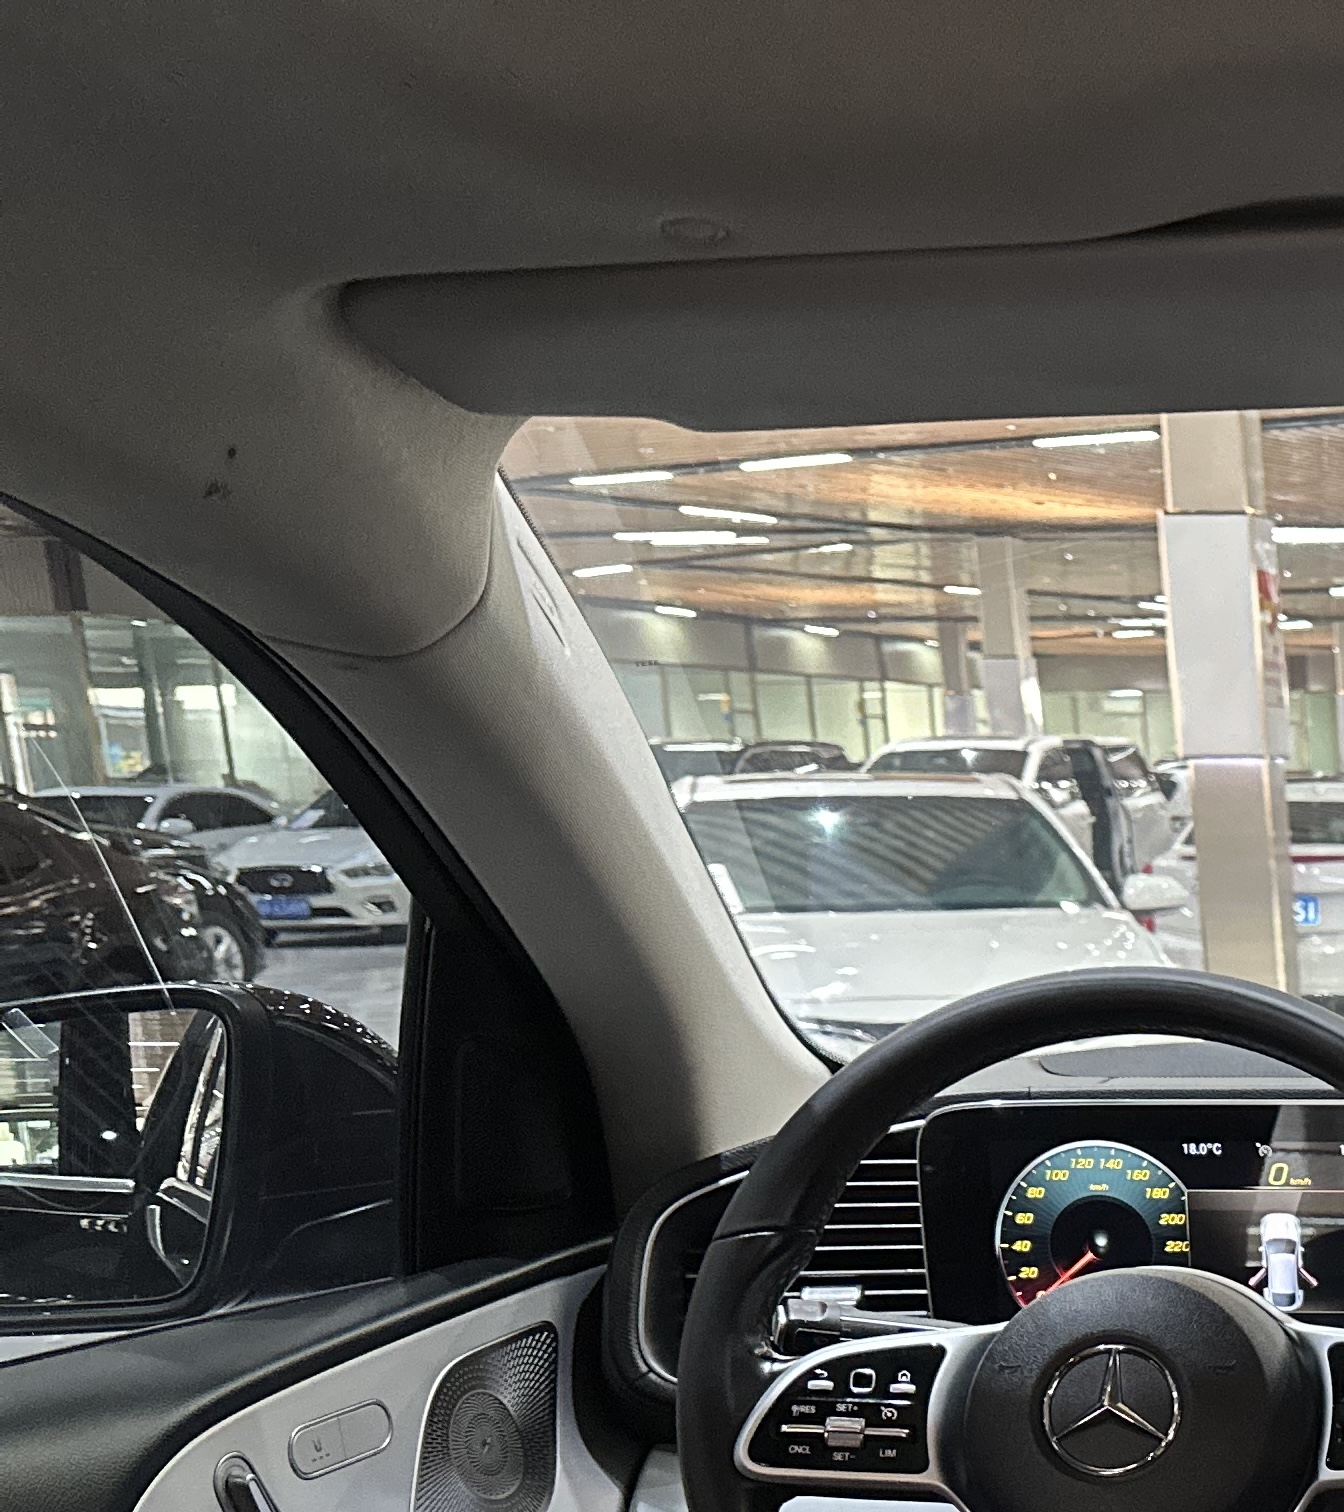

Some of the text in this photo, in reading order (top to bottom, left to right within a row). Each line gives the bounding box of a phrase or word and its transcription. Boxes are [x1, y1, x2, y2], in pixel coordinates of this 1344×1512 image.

[1070, 1158, 1094, 1169] 120
[1100, 1158, 1123, 1169] 140
[1045, 1170, 1069, 1181] 100
[1126, 1170, 1150, 1181] 160
[1268, 1163, 1288, 1185] 0
[1026, 1187, 1045, 1198] 80
[1146, 1188, 1170, 1199] 180
[1015, 1213, 1034, 1224] 60
[1159, 1213, 1185, 1225] 200
[1012, 1241, 1031, 1251] 40
[1018, 1267, 1039, 1278] 20
[788, 1445, 811, 1454] CNCL
[880, 1449, 897, 1458] LIM
